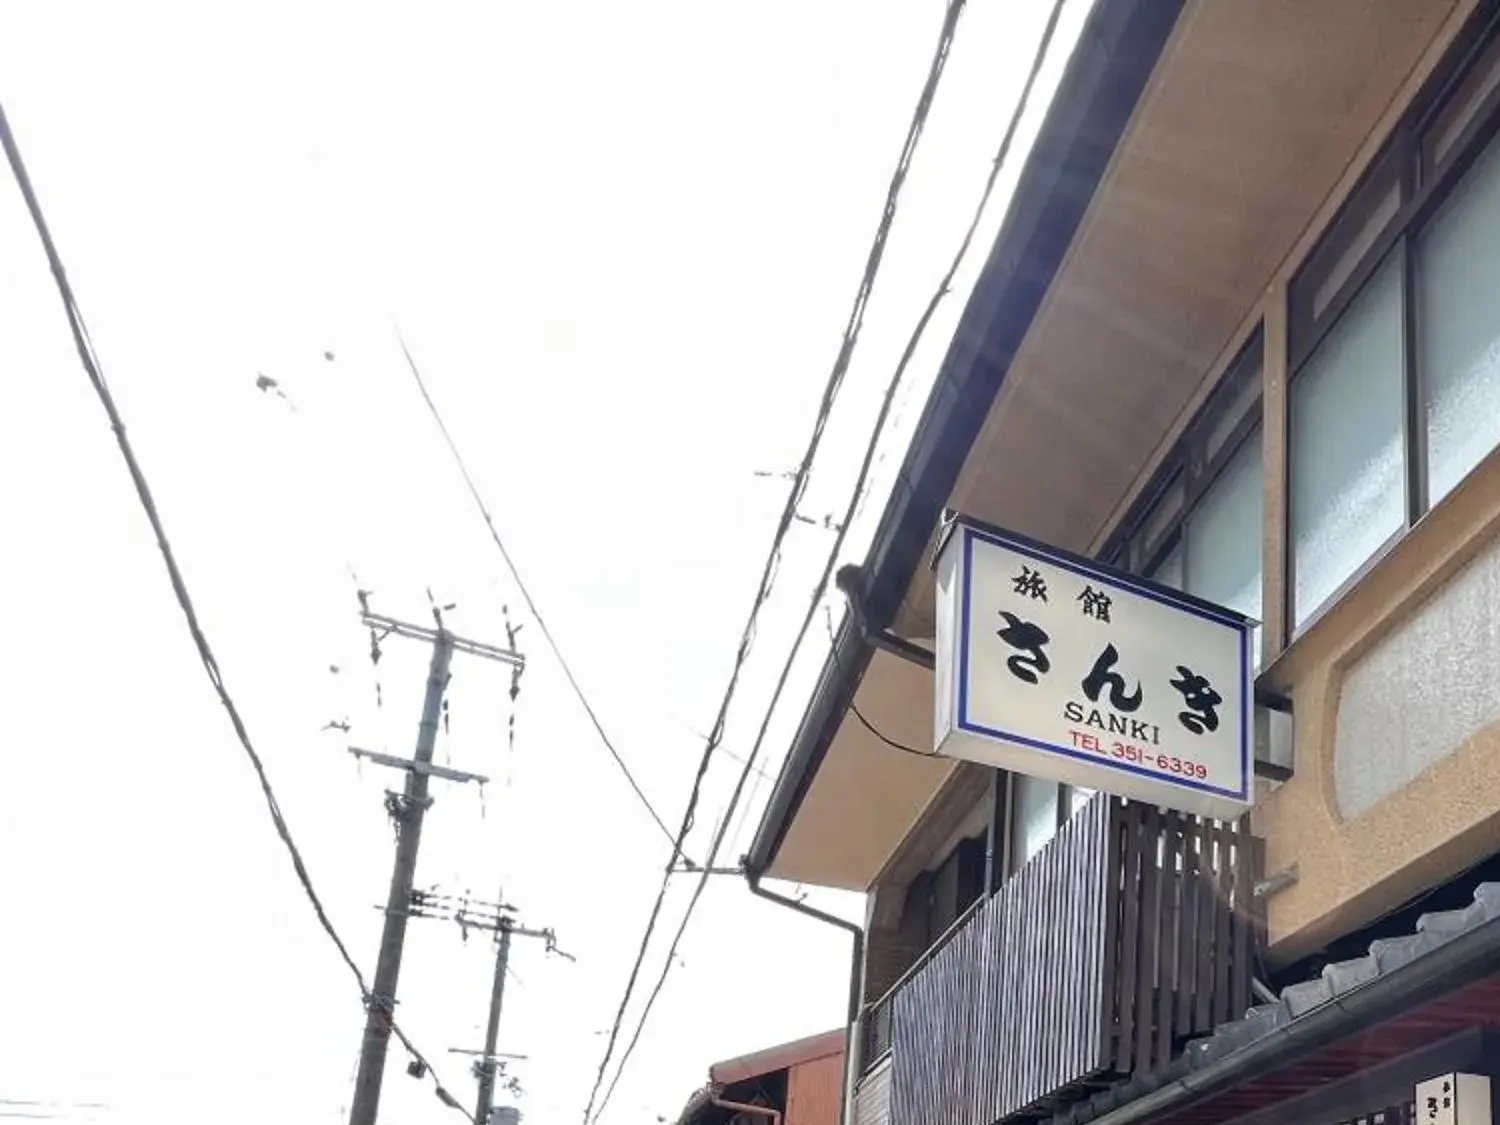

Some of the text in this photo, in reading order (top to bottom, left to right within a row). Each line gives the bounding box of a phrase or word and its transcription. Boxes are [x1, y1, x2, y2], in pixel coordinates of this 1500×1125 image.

[1011, 565, 1112, 624] 旅館
[997, 610, 1223, 735] さんき
[1064, 701, 1160, 745] SANKI
[1112, 741, 1208, 779] 351-6339
